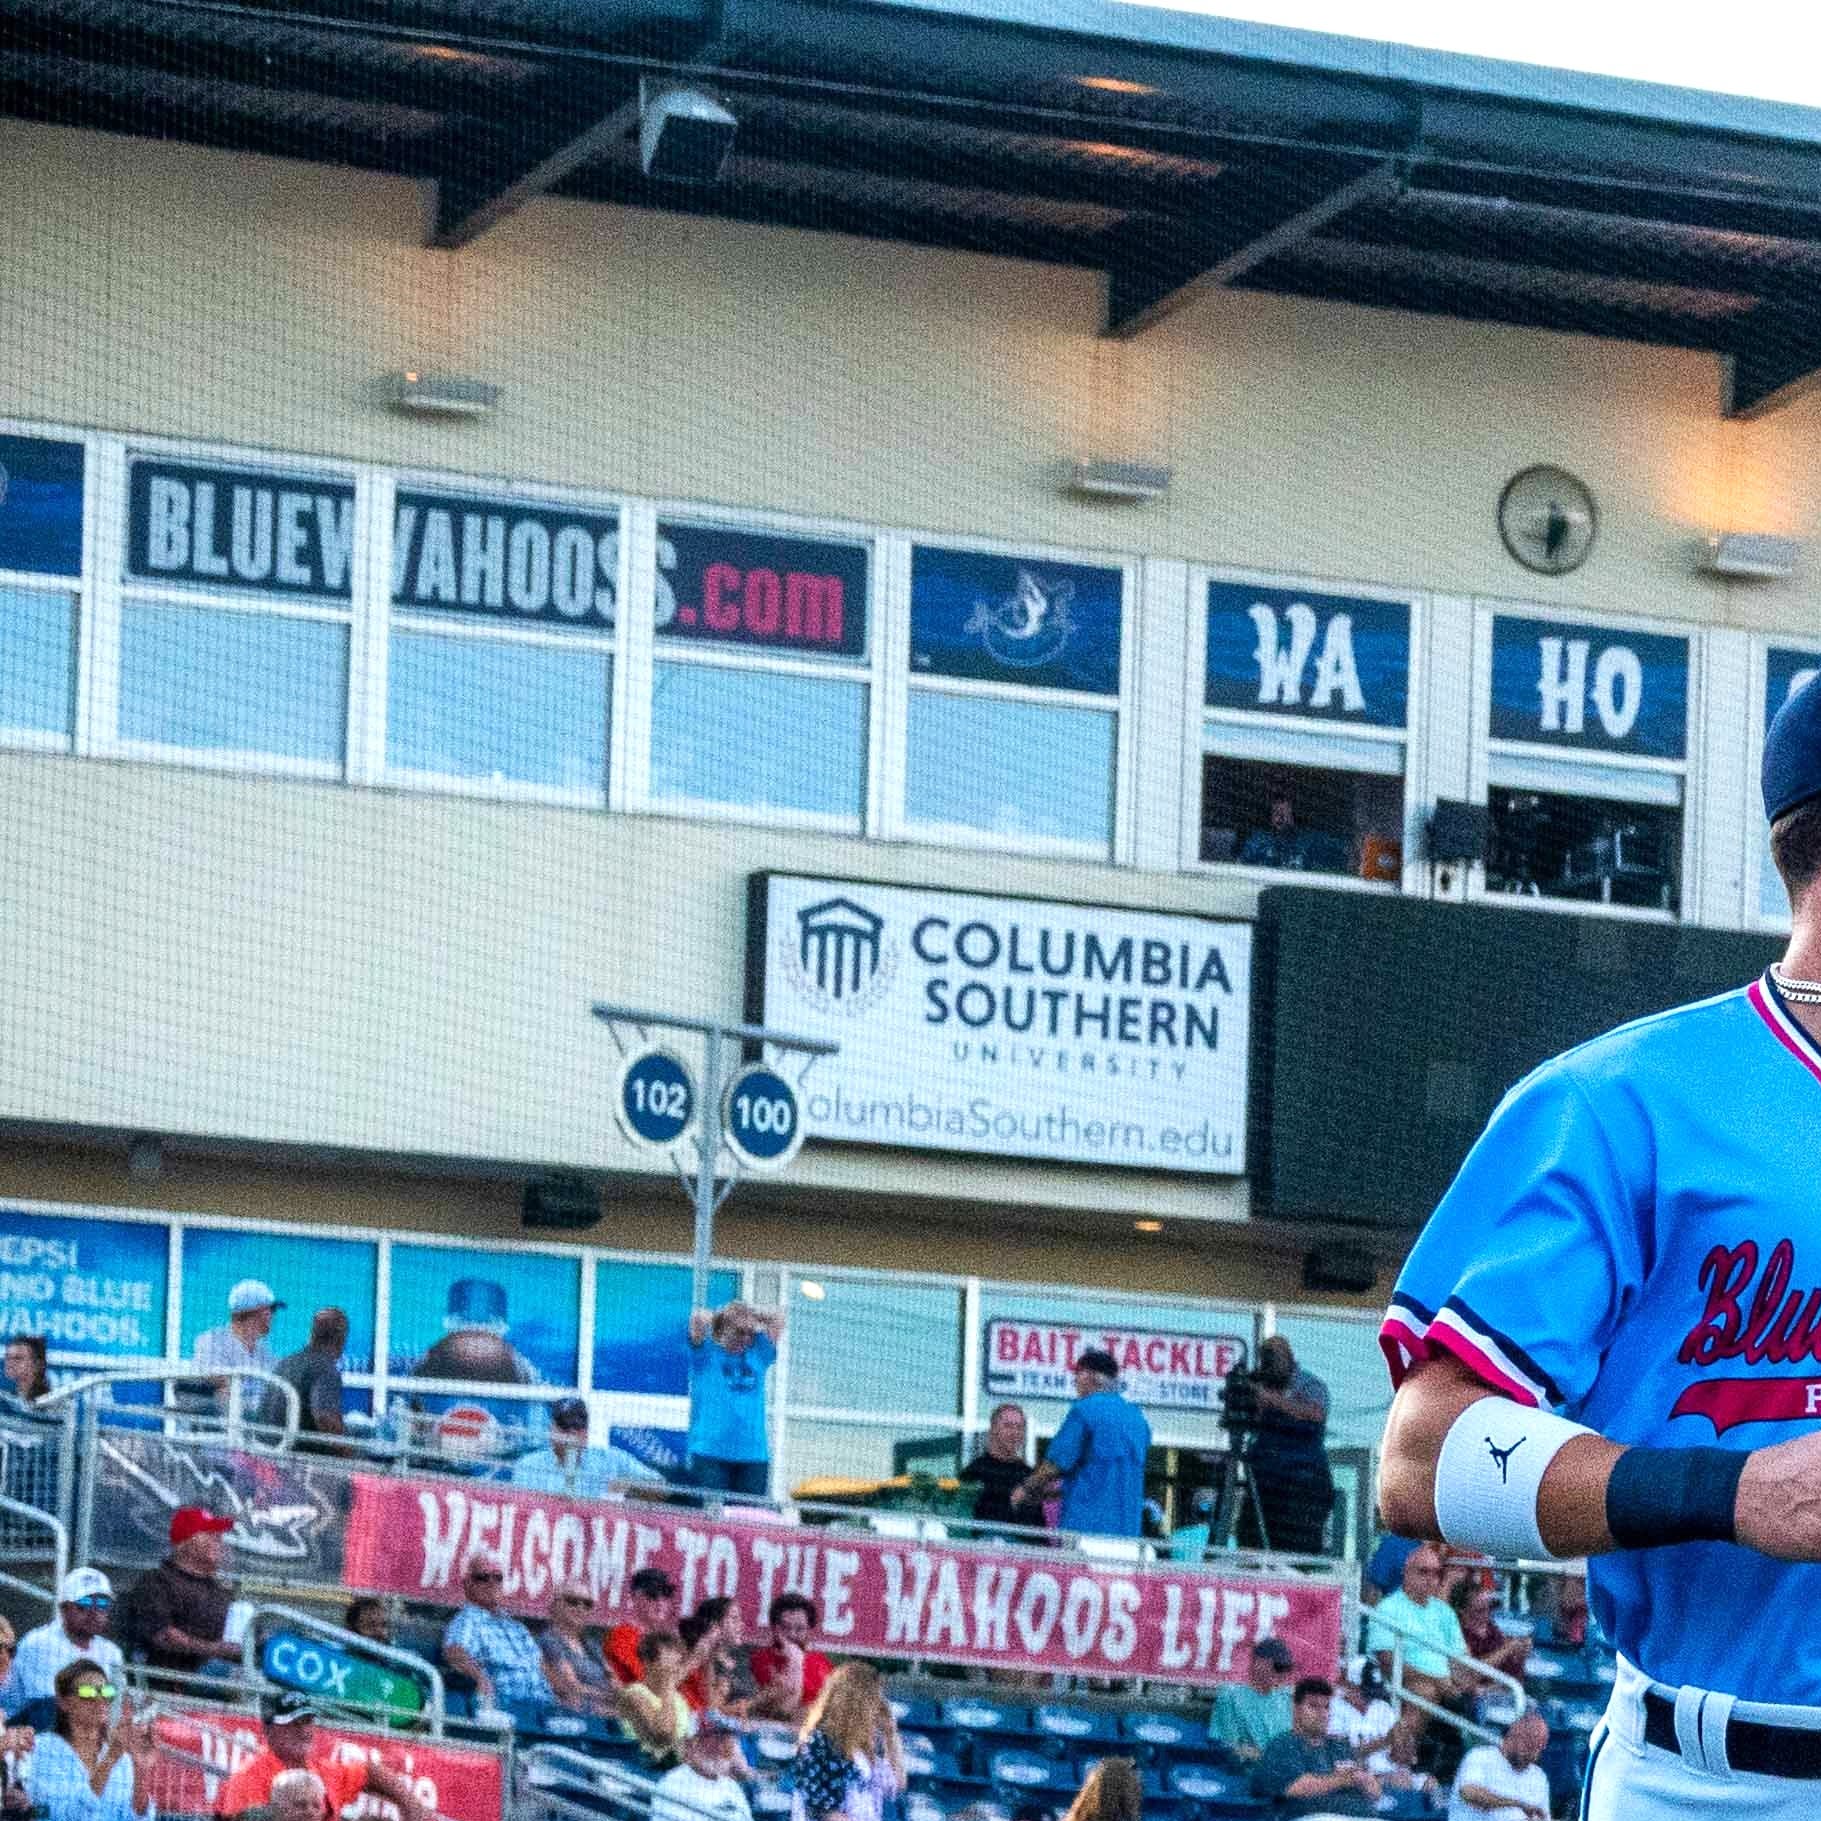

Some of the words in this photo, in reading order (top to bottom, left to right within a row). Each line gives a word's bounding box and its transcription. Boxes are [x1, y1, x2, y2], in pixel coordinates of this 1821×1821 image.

[1249, 600, 1367, 713] WA
[1536, 635, 1643, 739] HO
[912, 917, 1232, 993] COLUMBIA
[925, 978, 1220, 1051] SOUTHERN
[630, 1076, 687, 1117] 102
[953, 1042, 1187, 1081] UNIVERSITY
[736, 1092, 791, 1136] 100
[808, 1084, 1234, 1161] olumbiaSouthern.edu
[998, 1326, 1081, 1368] BAIT
[1102, 1335, 1235, 1379] TACKLE
[881, 1550, 1142, 1665] WAHOOS
[271, 1639, 350, 1697] COX
